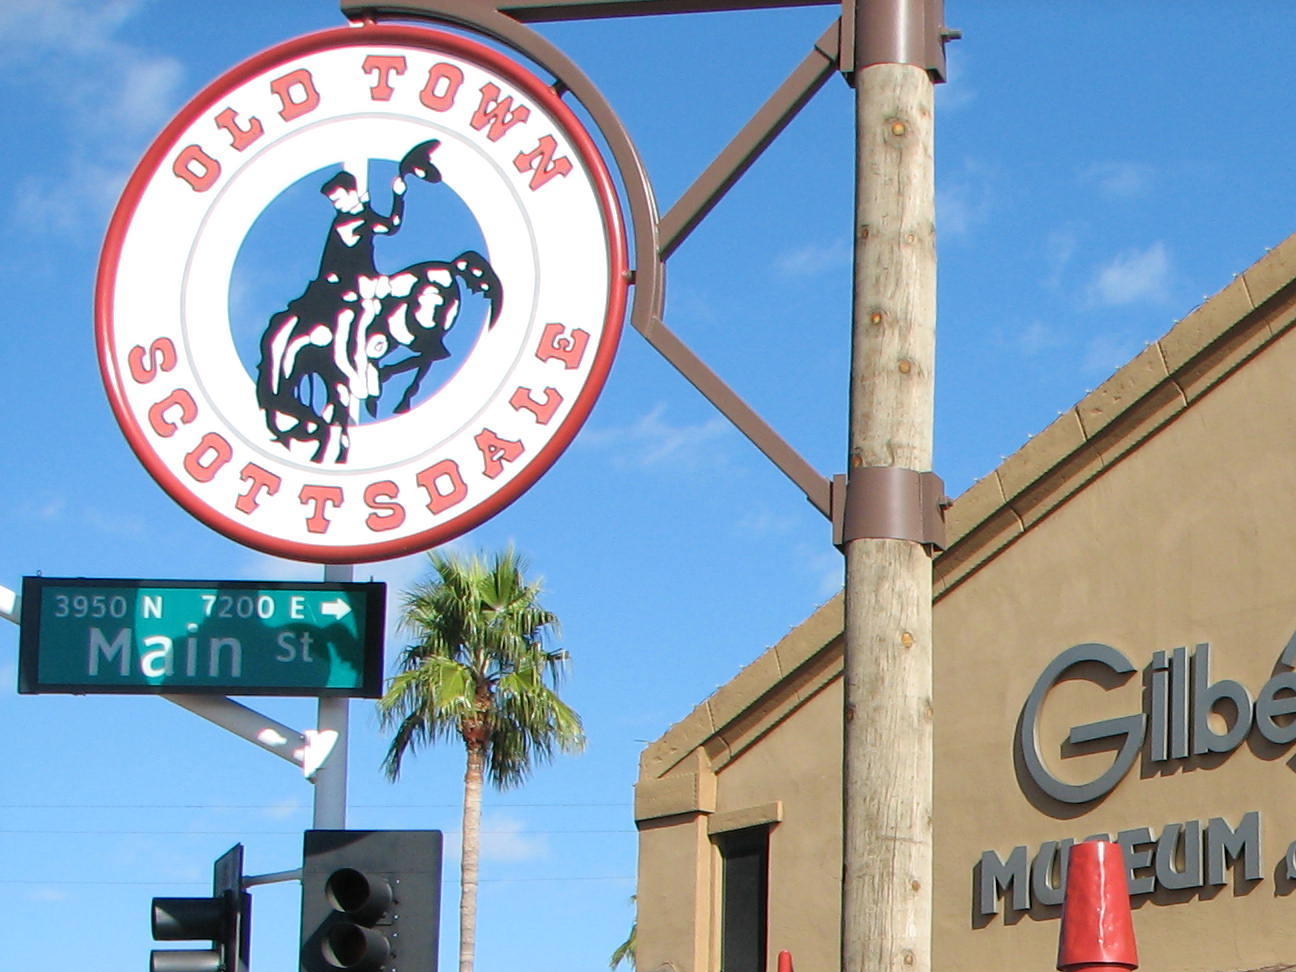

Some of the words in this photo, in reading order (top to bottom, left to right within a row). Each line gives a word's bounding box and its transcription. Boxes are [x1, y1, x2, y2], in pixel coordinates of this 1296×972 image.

[173, 68, 321, 192] OLD
[362, 55, 573, 191] TOWN
[128, 322, 590, 534] SCOTTSDALE
[54, 595, 127, 618] 3950
[143, 596, 163, 619] N
[202, 594, 275, 619] 7200
[290, 596, 305, 619] E
[88, 623, 243, 678] Main
[276, 630, 315, 664] St
[979, 811, 1264, 915] MUEUM
